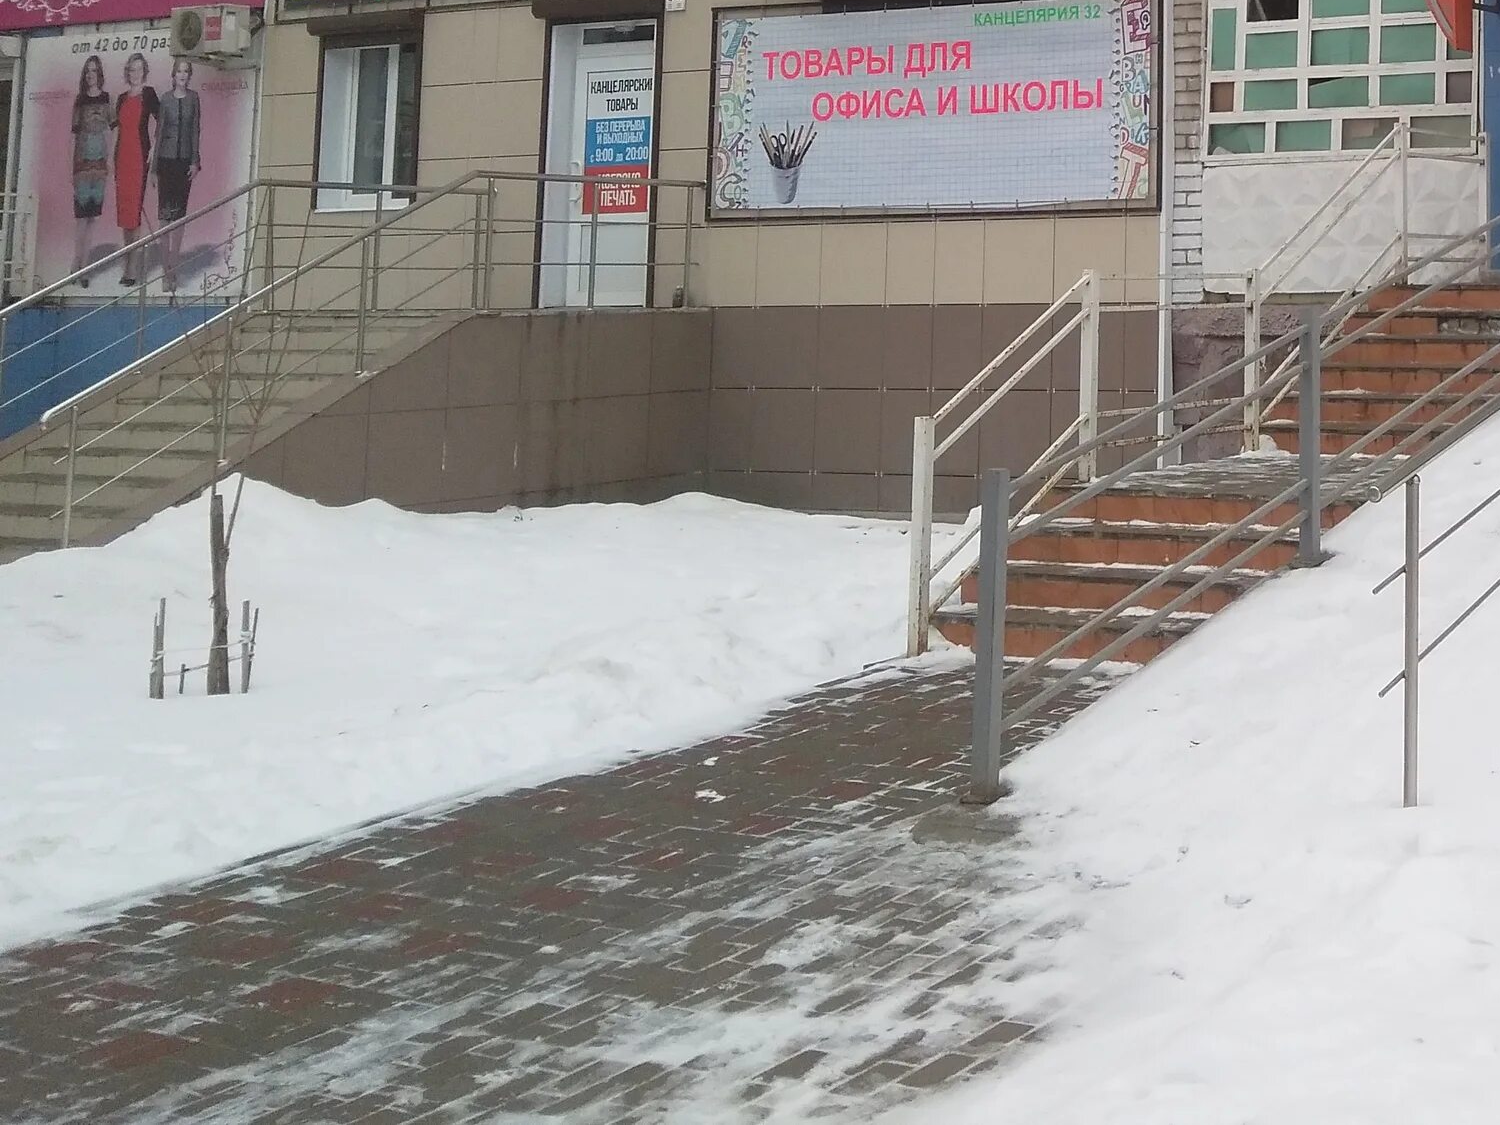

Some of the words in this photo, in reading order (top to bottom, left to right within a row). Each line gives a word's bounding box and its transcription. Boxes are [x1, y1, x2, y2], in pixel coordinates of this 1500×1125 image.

[974, 8, 1080, 26] КАНЦЕЛЯРИЯ
[1084, 4, 1101, 19] 32
[94, 38, 110, 52] 42
[133, 35, 149, 50] 70
[762, 45, 894, 81] ТОВАРЫ
[903, 40, 972, 79] ДЛЯ
[606, 98, 639, 112] ТОВАРЫ
[811, 87, 927, 122] ОФИСА
[937, 85, 957, 115] И
[969, 78, 1103, 114] ШКОЛЫ
[595, 121, 609, 133] БЕЗ
[610, 119, 646, 132] ПЕРЕРЫВА
[604, 131, 644, 144] ВЫХОДНЫХ
[595, 148, 614, 162] 9:00
[625, 146, 649, 161] 20:00
[600, 190, 637, 207] ПЕЧАТЬ
